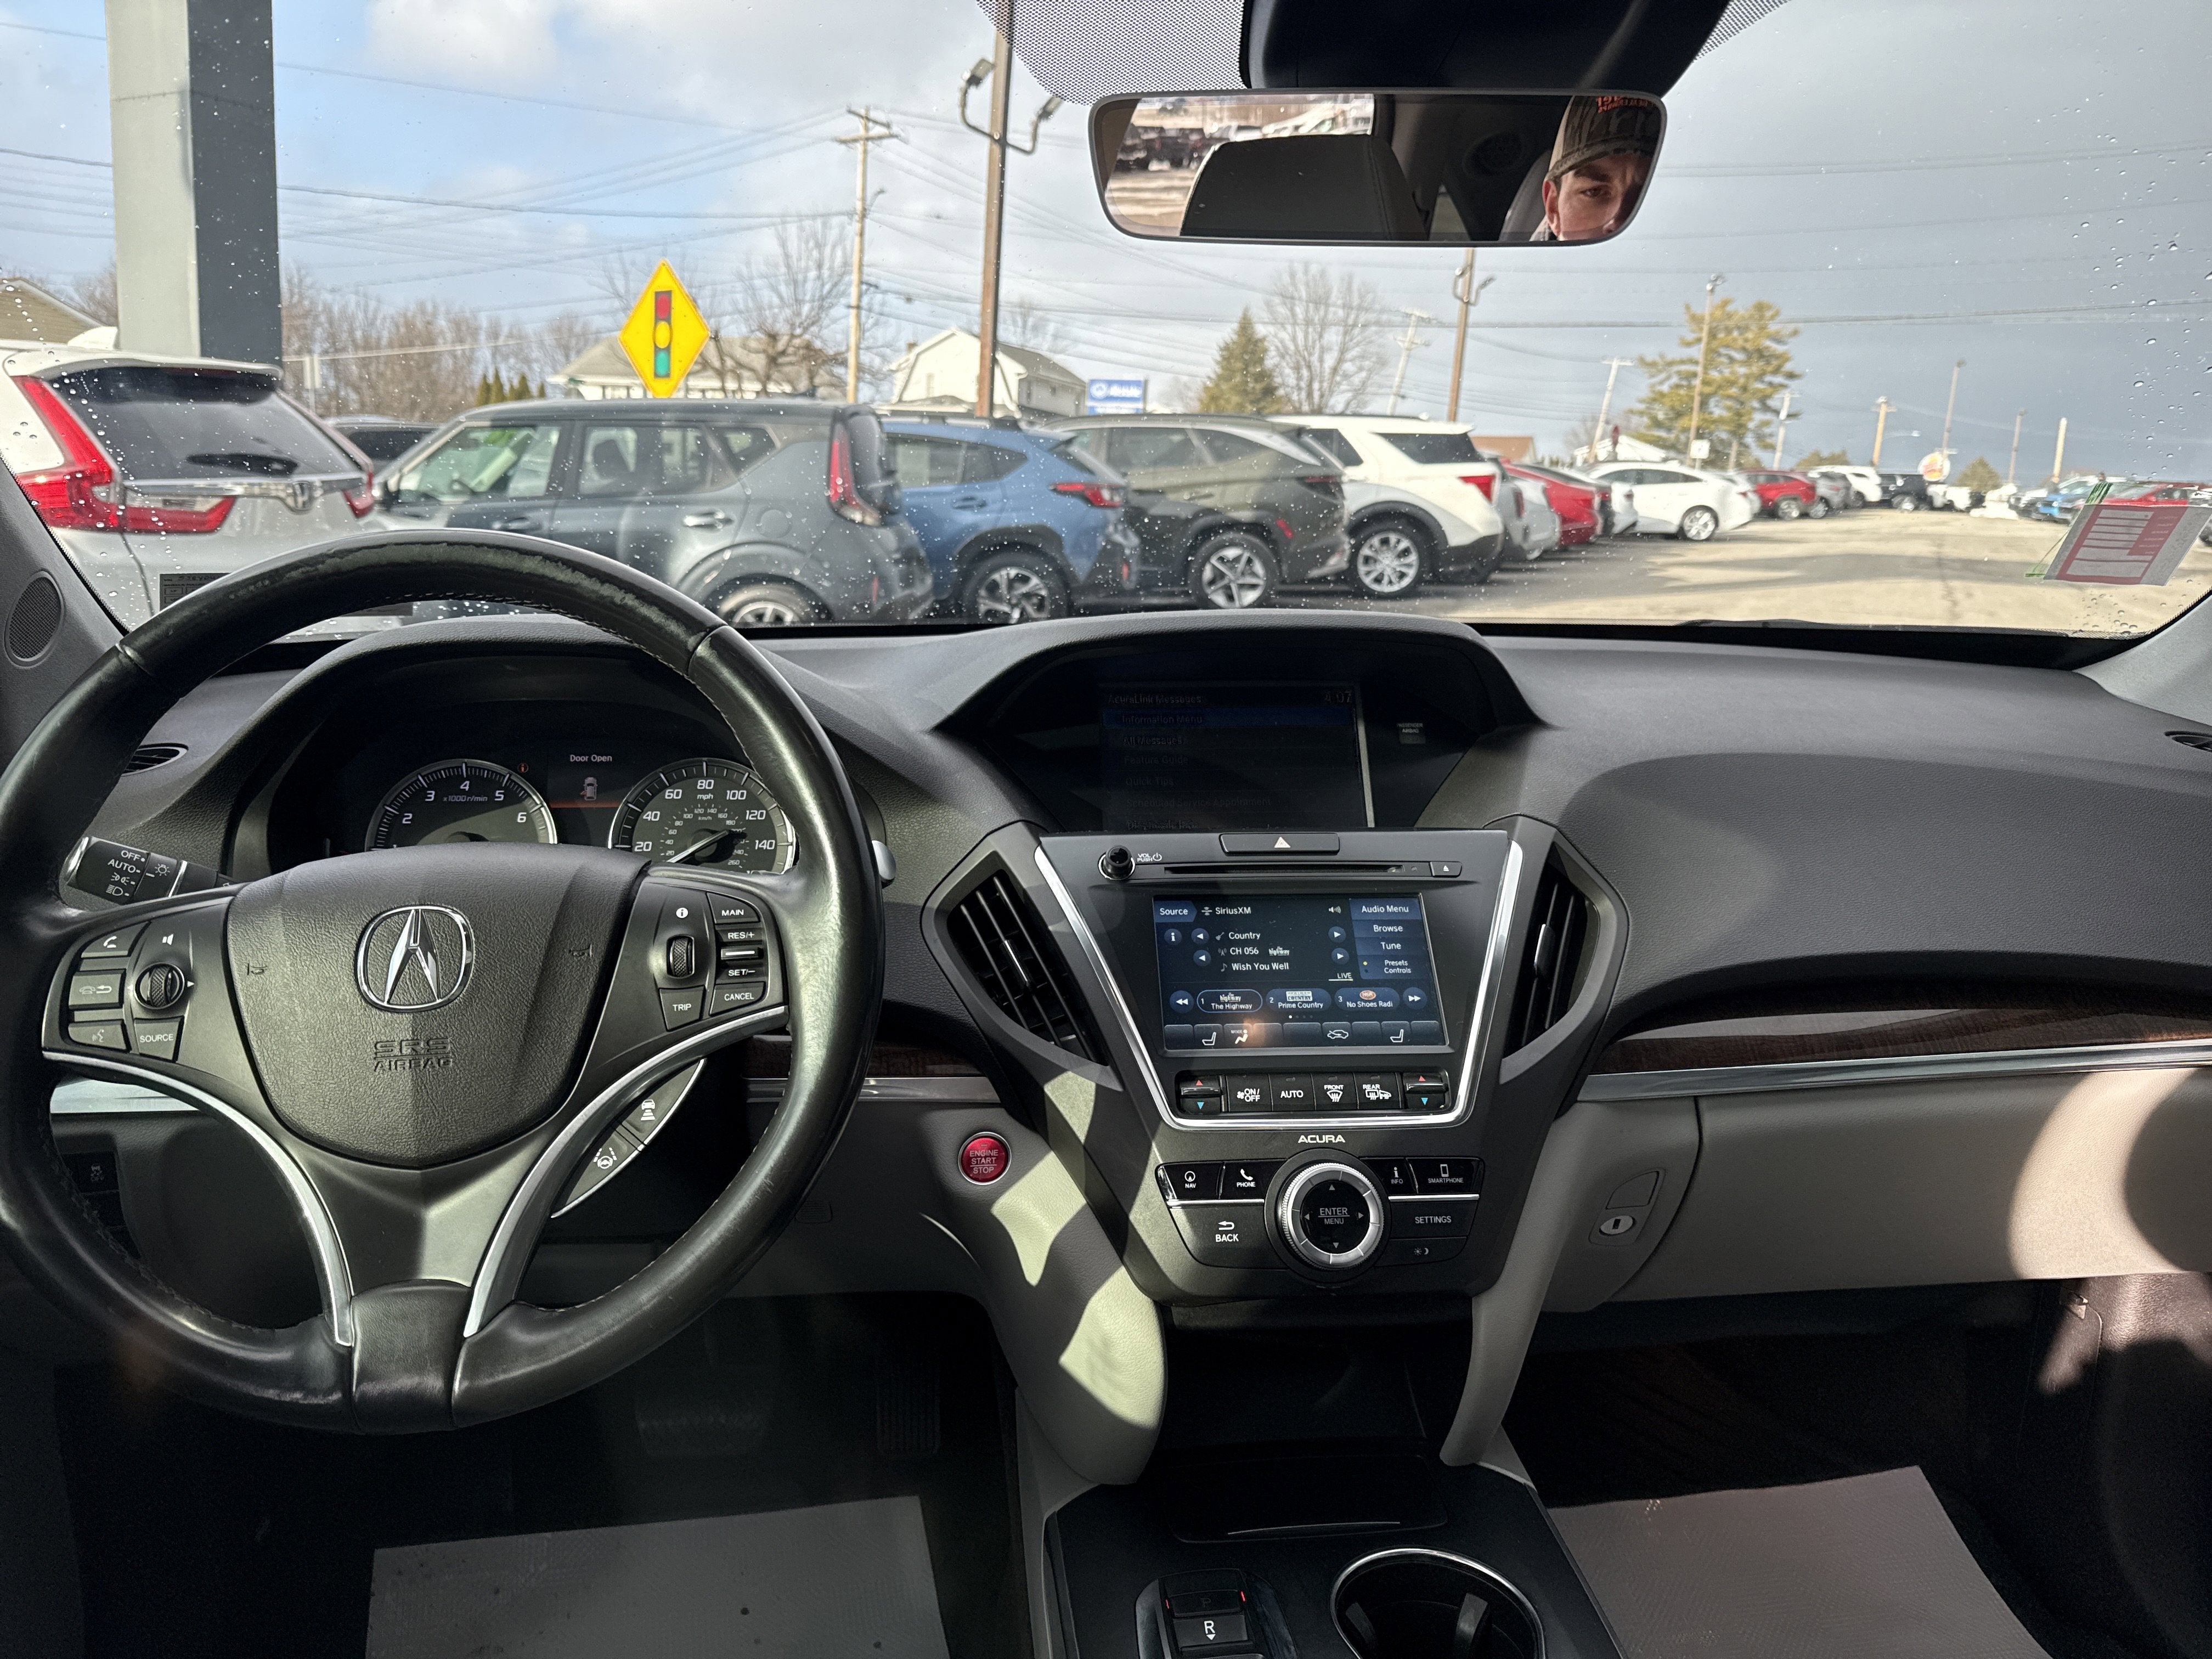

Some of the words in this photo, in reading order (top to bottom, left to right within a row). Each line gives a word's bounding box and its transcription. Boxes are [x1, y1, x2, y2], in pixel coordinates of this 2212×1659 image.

[1154, 693, 1202, 704] Messages
[1122, 714, 1173, 724] Information
[1176, 714, 1203, 724] Menu
[1123, 736, 1135, 746] All
[1136, 736, 1183, 747] Messages
[569, 754, 589, 763] Door
[590, 754, 613, 763] Open
[460, 780, 470, 791] 4
[697, 779, 714, 789] 80
[425, 790, 435, 802] 3
[467, 794, 488, 802] r/min
[494, 790, 505, 801] 5
[665, 789, 682, 799] 60
[726, 790, 747, 800] 100
[402, 814, 413, 824] 2
[516, 812, 527, 822] 6
[642, 811, 660, 821] 40
[746, 810, 766, 820] 120
[634, 841, 652, 851] 20
[755, 839, 775, 850] 140
[121, 850, 141, 861] OFF
[108, 859, 136, 873] AUTO
[1159, 907, 1188, 916] Source
[1215, 906, 1251, 915] SiriusXM
[1373, 924, 1403, 933] Browse
[1228, 932, 1261, 941] Country
[1229, 947, 1242, 956] CH
[1244, 946, 1259, 955] 056
[1232, 963, 1252, 971] Wish
[1254, 962, 1269, 970] You
[1271, 962, 1289, 970] Well
[724, 992, 754, 1001] CANCEL
[672, 1003, 692, 1011] TRIP
[1225, 1002, 1252, 1011] Highway
[1297, 1001, 1323, 1009] Country
[139, 1033, 174, 1043] SOURCE
[374, 1037, 450, 1056] SRS
[373, 1057, 454, 1073] AIRBAG
[1280, 1090, 1304, 1098] AUTO
[1297, 1135, 1346, 1143] ACURA
[1319, 1207, 1348, 1216] ENTER
[1324, 1217, 1344, 1226] MENU
[1414, 1215, 1452, 1224] SETTINGS
[1215, 1233, 1239, 1244] BACK
[1204, 1620, 1216, 1634] R
